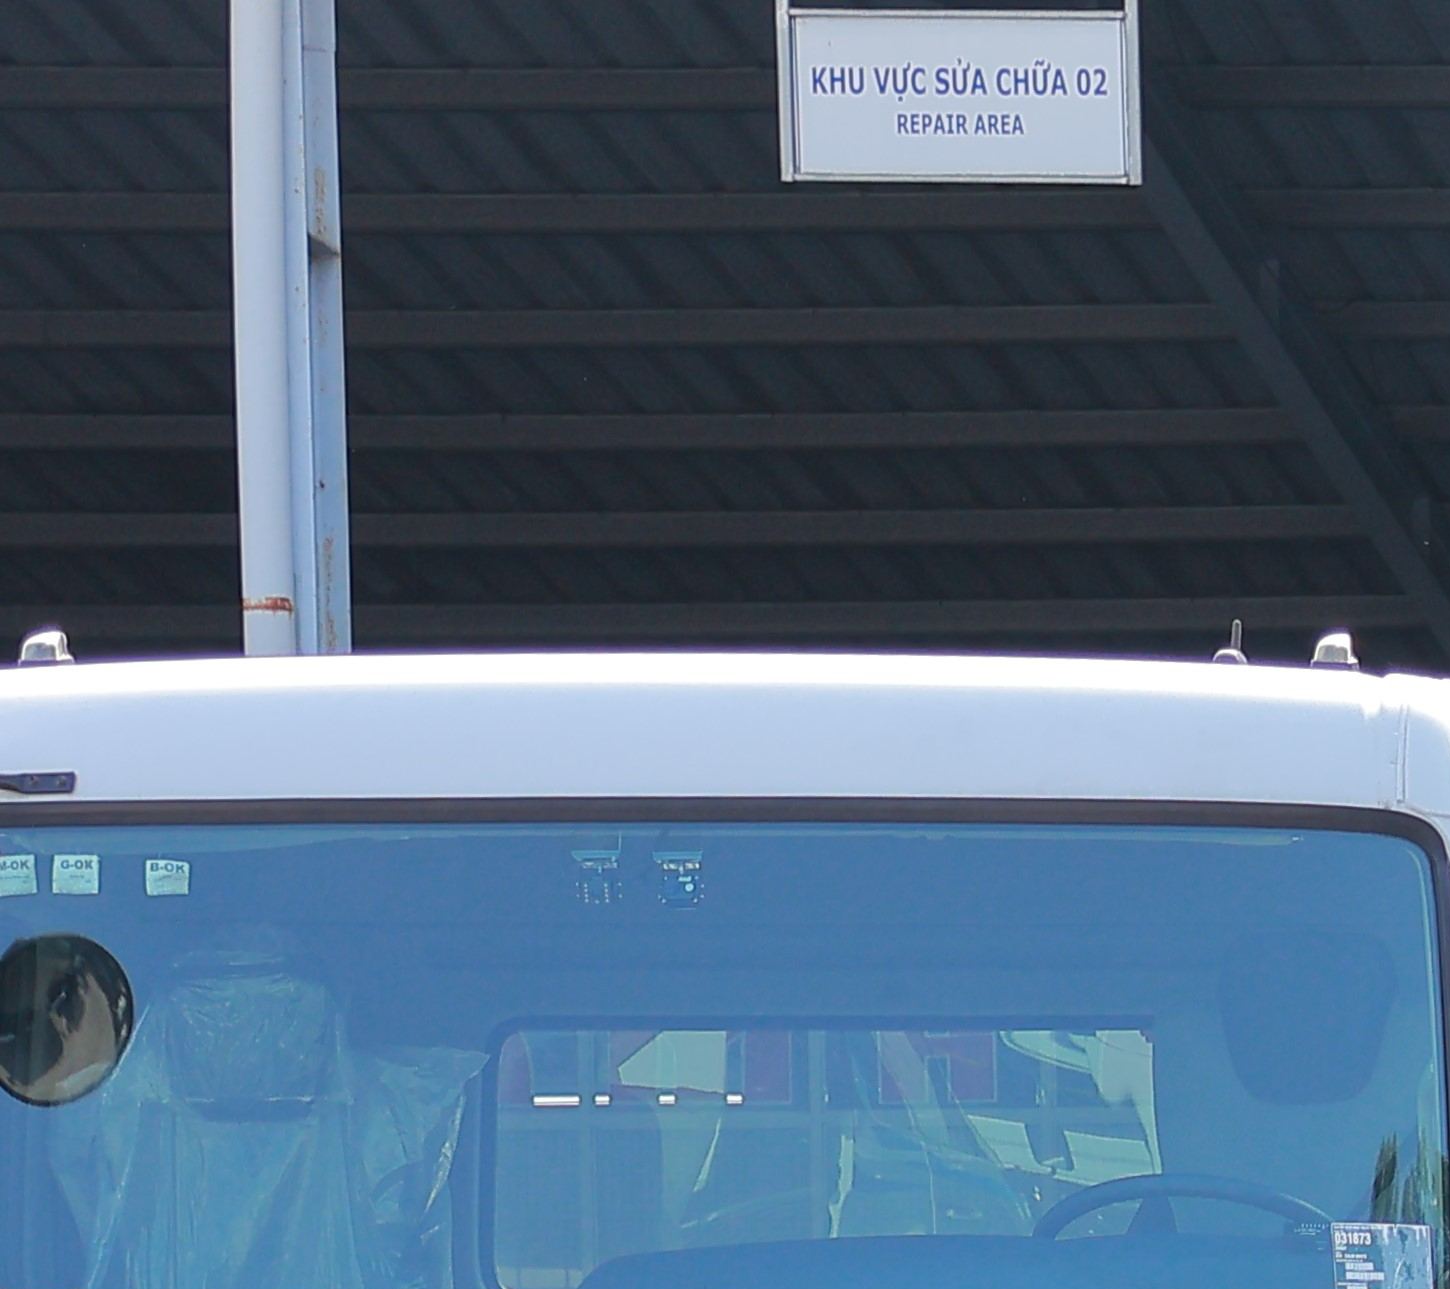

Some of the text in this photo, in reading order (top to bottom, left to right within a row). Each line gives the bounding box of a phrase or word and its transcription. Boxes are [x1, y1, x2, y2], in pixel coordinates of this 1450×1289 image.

[811, 58, 1108, 102] KHU VỰC SỬA CHỮA 02
[896, 113, 1024, 136] REPAIR AREA
[60, 859, 94, 870] G-OK
[150, 863, 185, 874] B-OK
[1334, 1231, 1372, 1245] 031873
